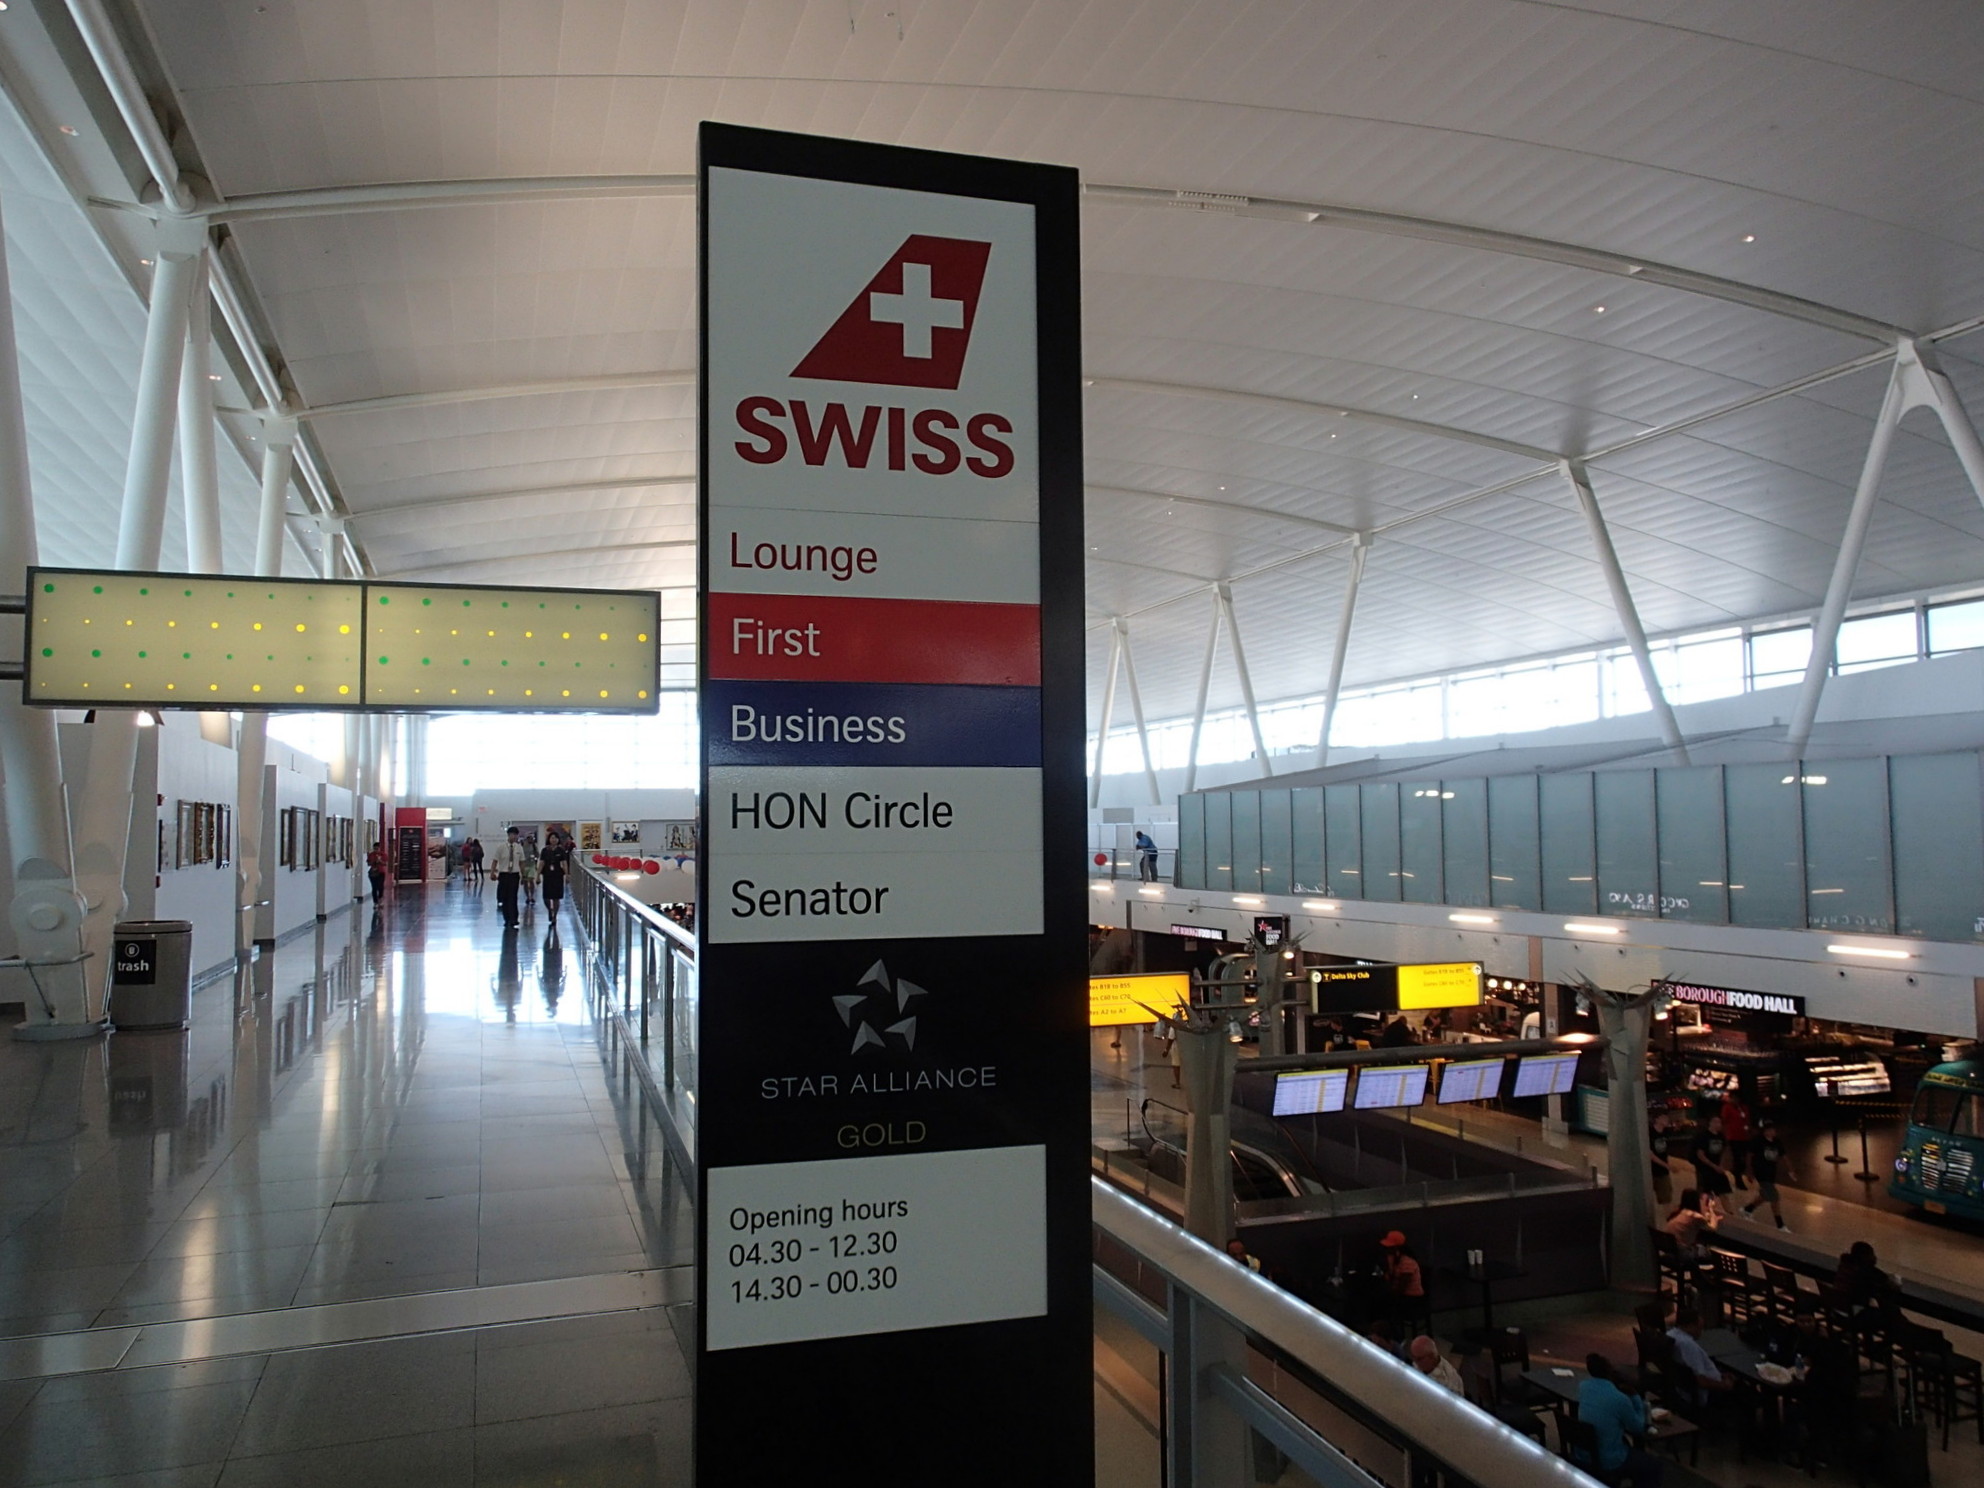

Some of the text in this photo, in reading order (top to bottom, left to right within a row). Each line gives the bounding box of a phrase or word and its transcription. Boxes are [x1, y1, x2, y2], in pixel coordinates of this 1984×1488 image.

[734, 396, 1015, 478] SWISS
[730, 532, 878, 581] Lounge
[732, 618, 821, 657] First
[731, 705, 906, 743] Business
[731, 792, 953, 829] HON Circle
[731, 880, 889, 918] Senator
[118, 960, 149, 971] trash
[1346, 972, 1357, 981] Sky
[1357, 971, 1370, 979] Club
[1675, 985, 1729, 1005] BOROUGH
[1729, 991, 1763, 1010] FOOD
[1764, 998, 1798, 1015] HALL
[761, 1066, 997, 1099] STAR ALLIANCE
[837, 1121, 927, 1148] GOLD
[729, 1199, 909, 1234] Opening hours
[729, 1239, 802, 1267] 04.30
[829, 1231, 898, 1258] 12.30
[731, 1275, 802, 1303] 14.30
[827, 1266, 898, 1294] 00.30
